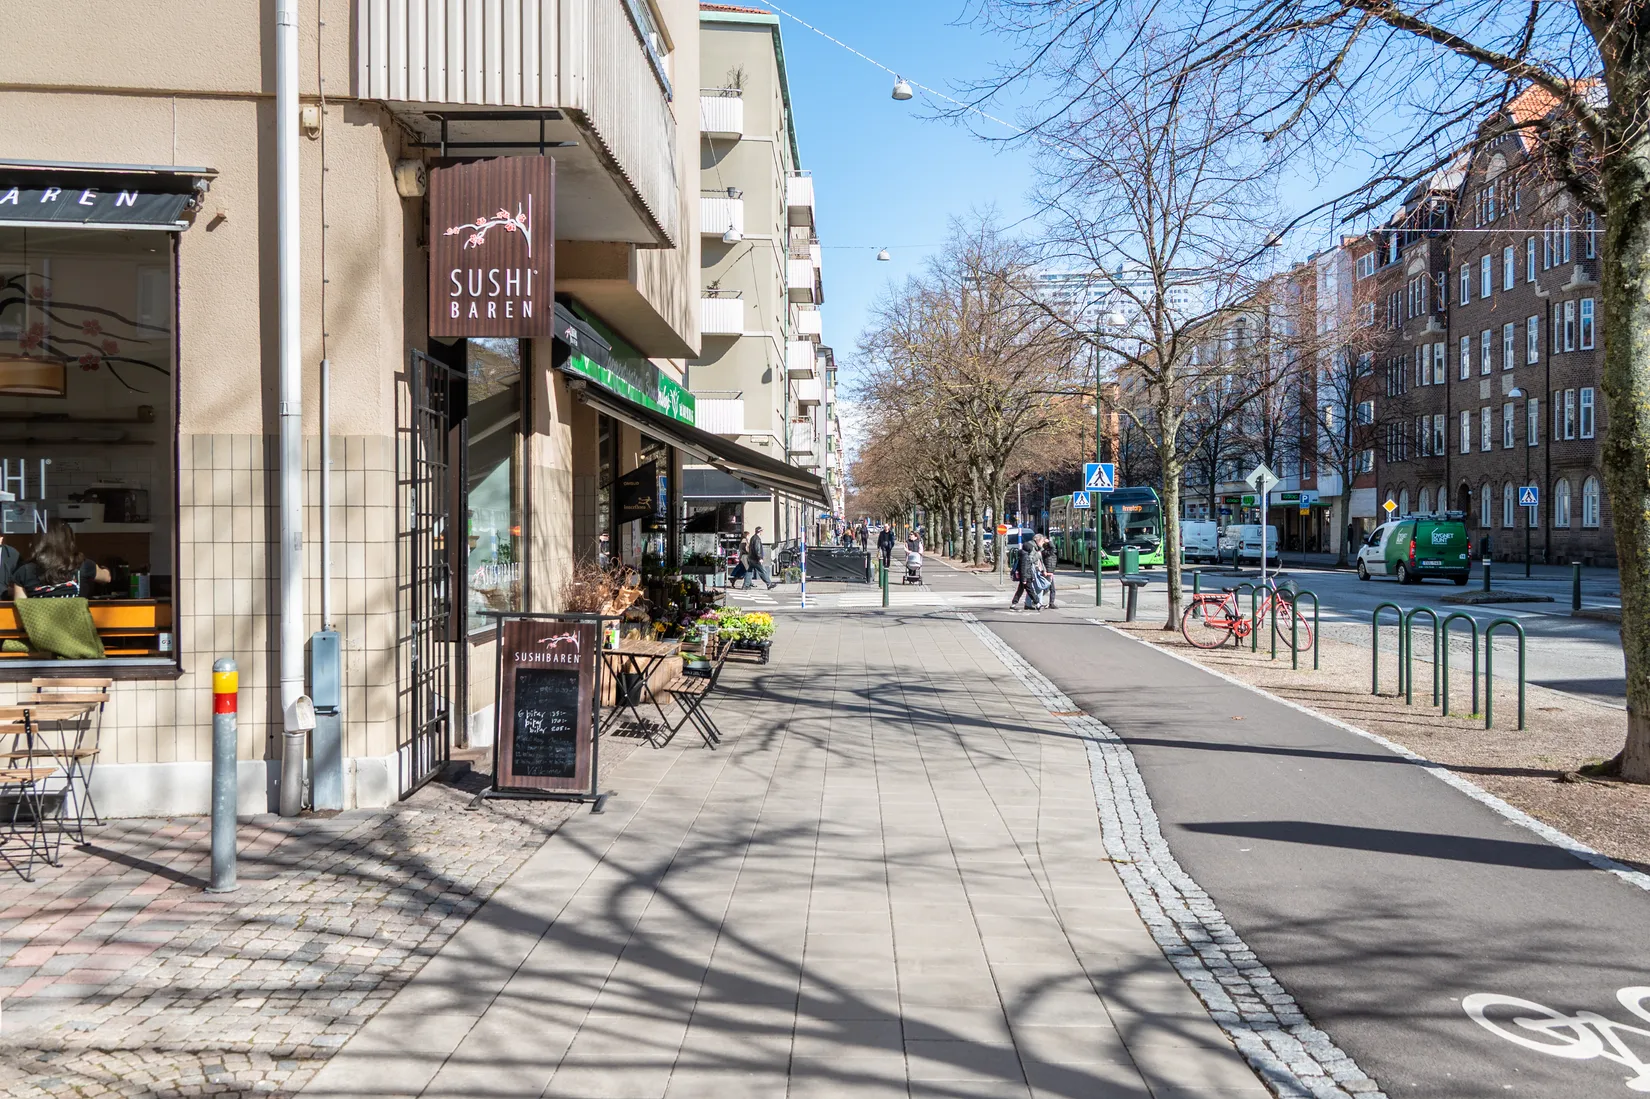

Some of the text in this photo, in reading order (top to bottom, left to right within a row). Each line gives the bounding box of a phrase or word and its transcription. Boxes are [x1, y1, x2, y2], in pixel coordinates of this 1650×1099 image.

[0, 187, 139, 207] AREN
[450, 268, 532, 297] SUSHI
[451, 301, 532, 318] BAREN
[0, 458, 46, 500] HI
[515, 651, 579, 664] SUSHIBAREN
